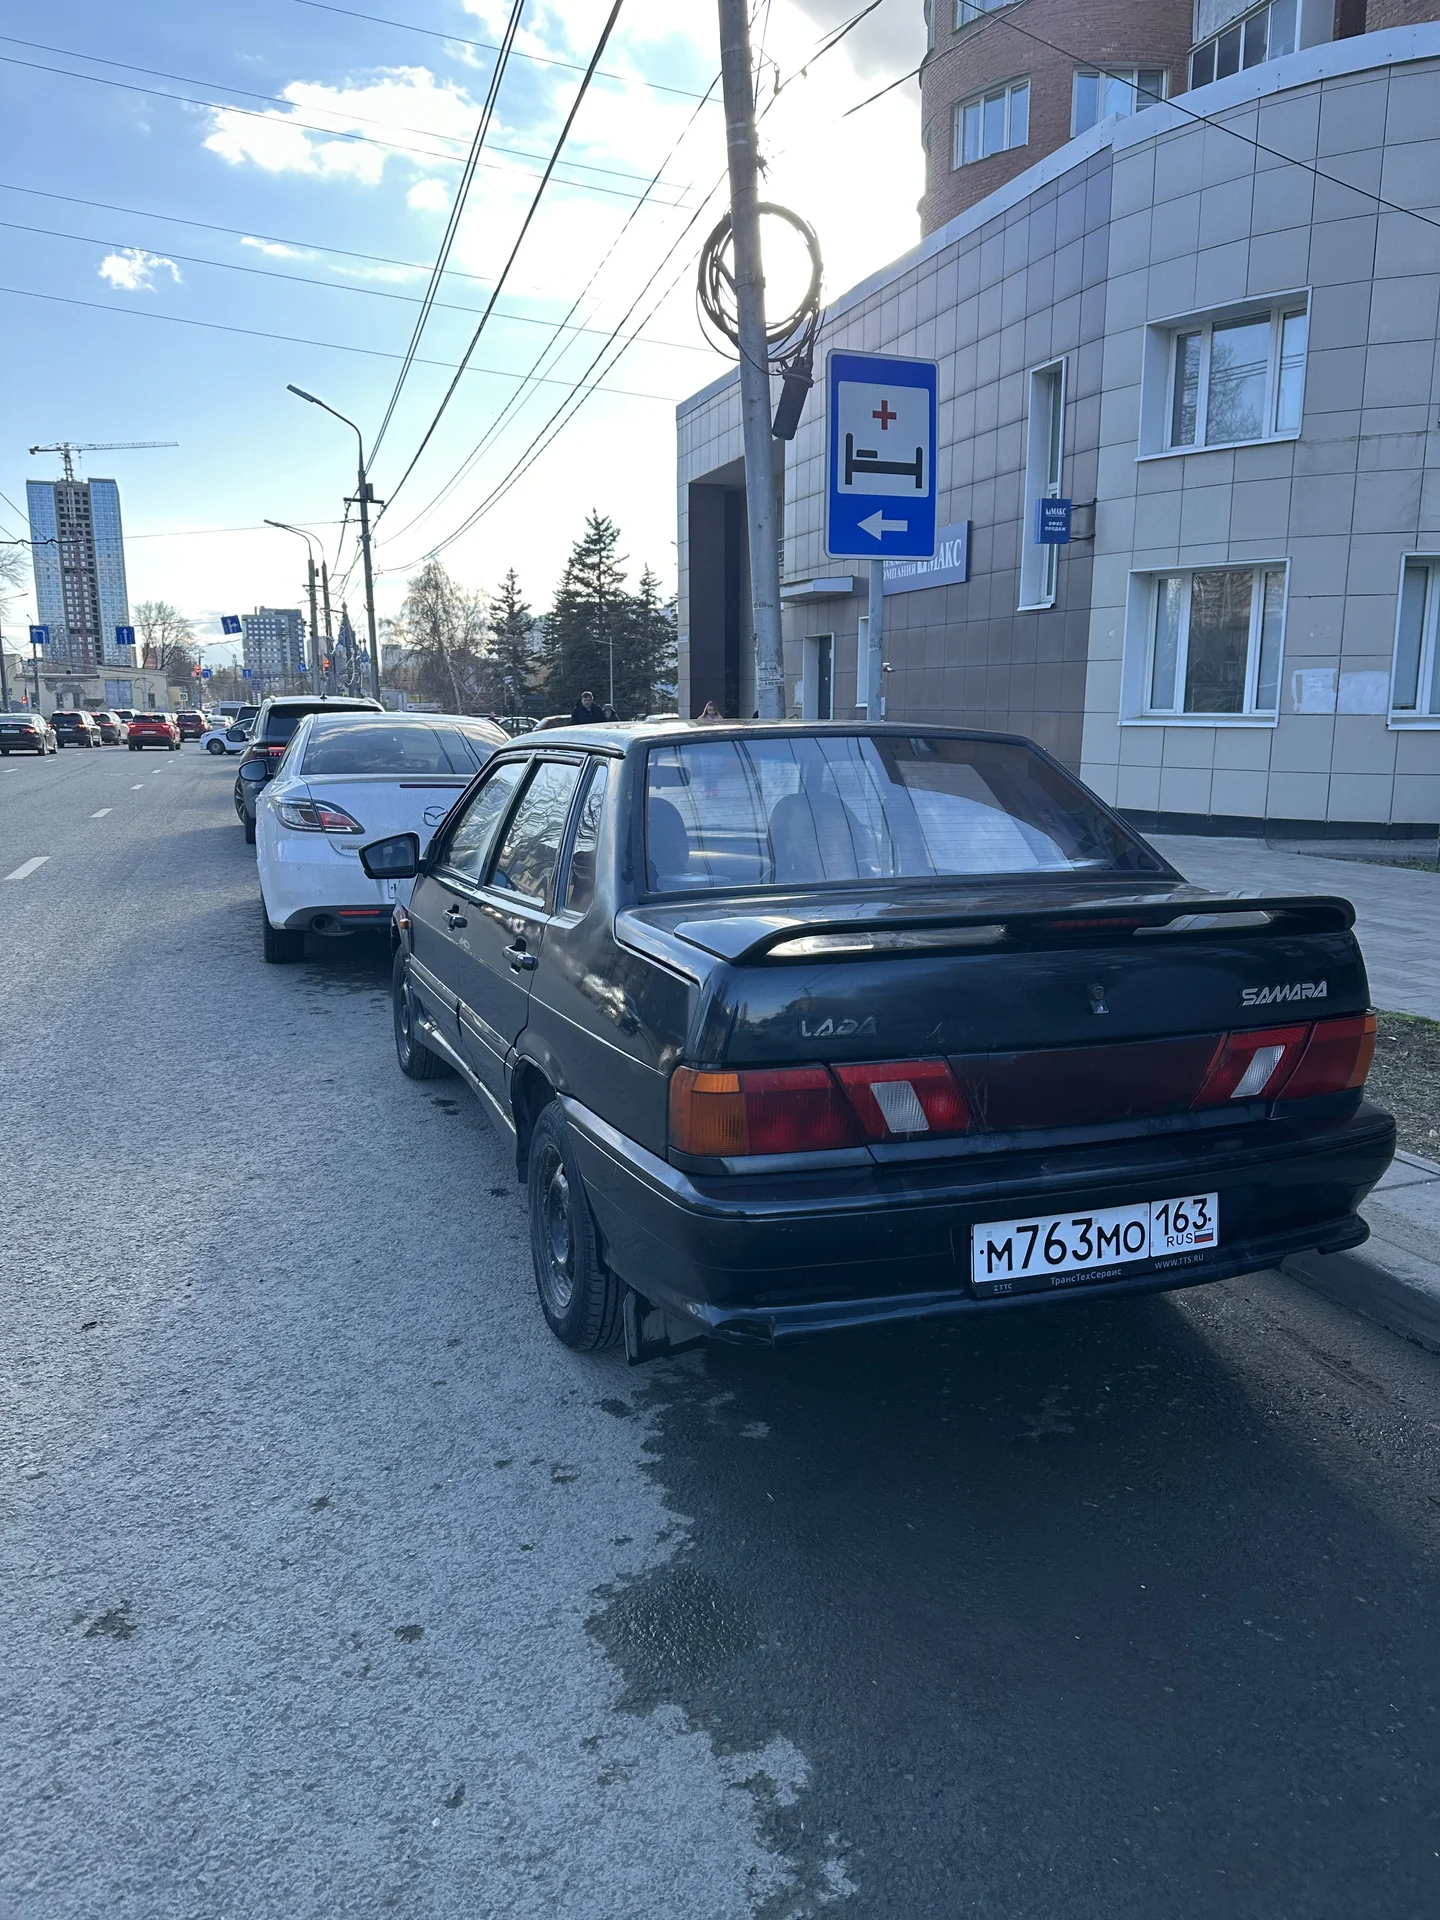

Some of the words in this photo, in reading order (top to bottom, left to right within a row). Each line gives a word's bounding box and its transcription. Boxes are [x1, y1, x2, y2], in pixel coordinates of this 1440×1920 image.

[1241, 980, 1328, 1006] SAMARA
[801, 1015, 876, 1037] LADA
[986, 1217, 1146, 1274] М763МО
[1155, 1197, 1208, 1236] 163
[1166, 1232, 1194, 1248] RUS
[1154, 1253, 1204, 1269] WWW.TTS.RU
[1050, 1268, 1122, 1286] ТрансТехСервис
